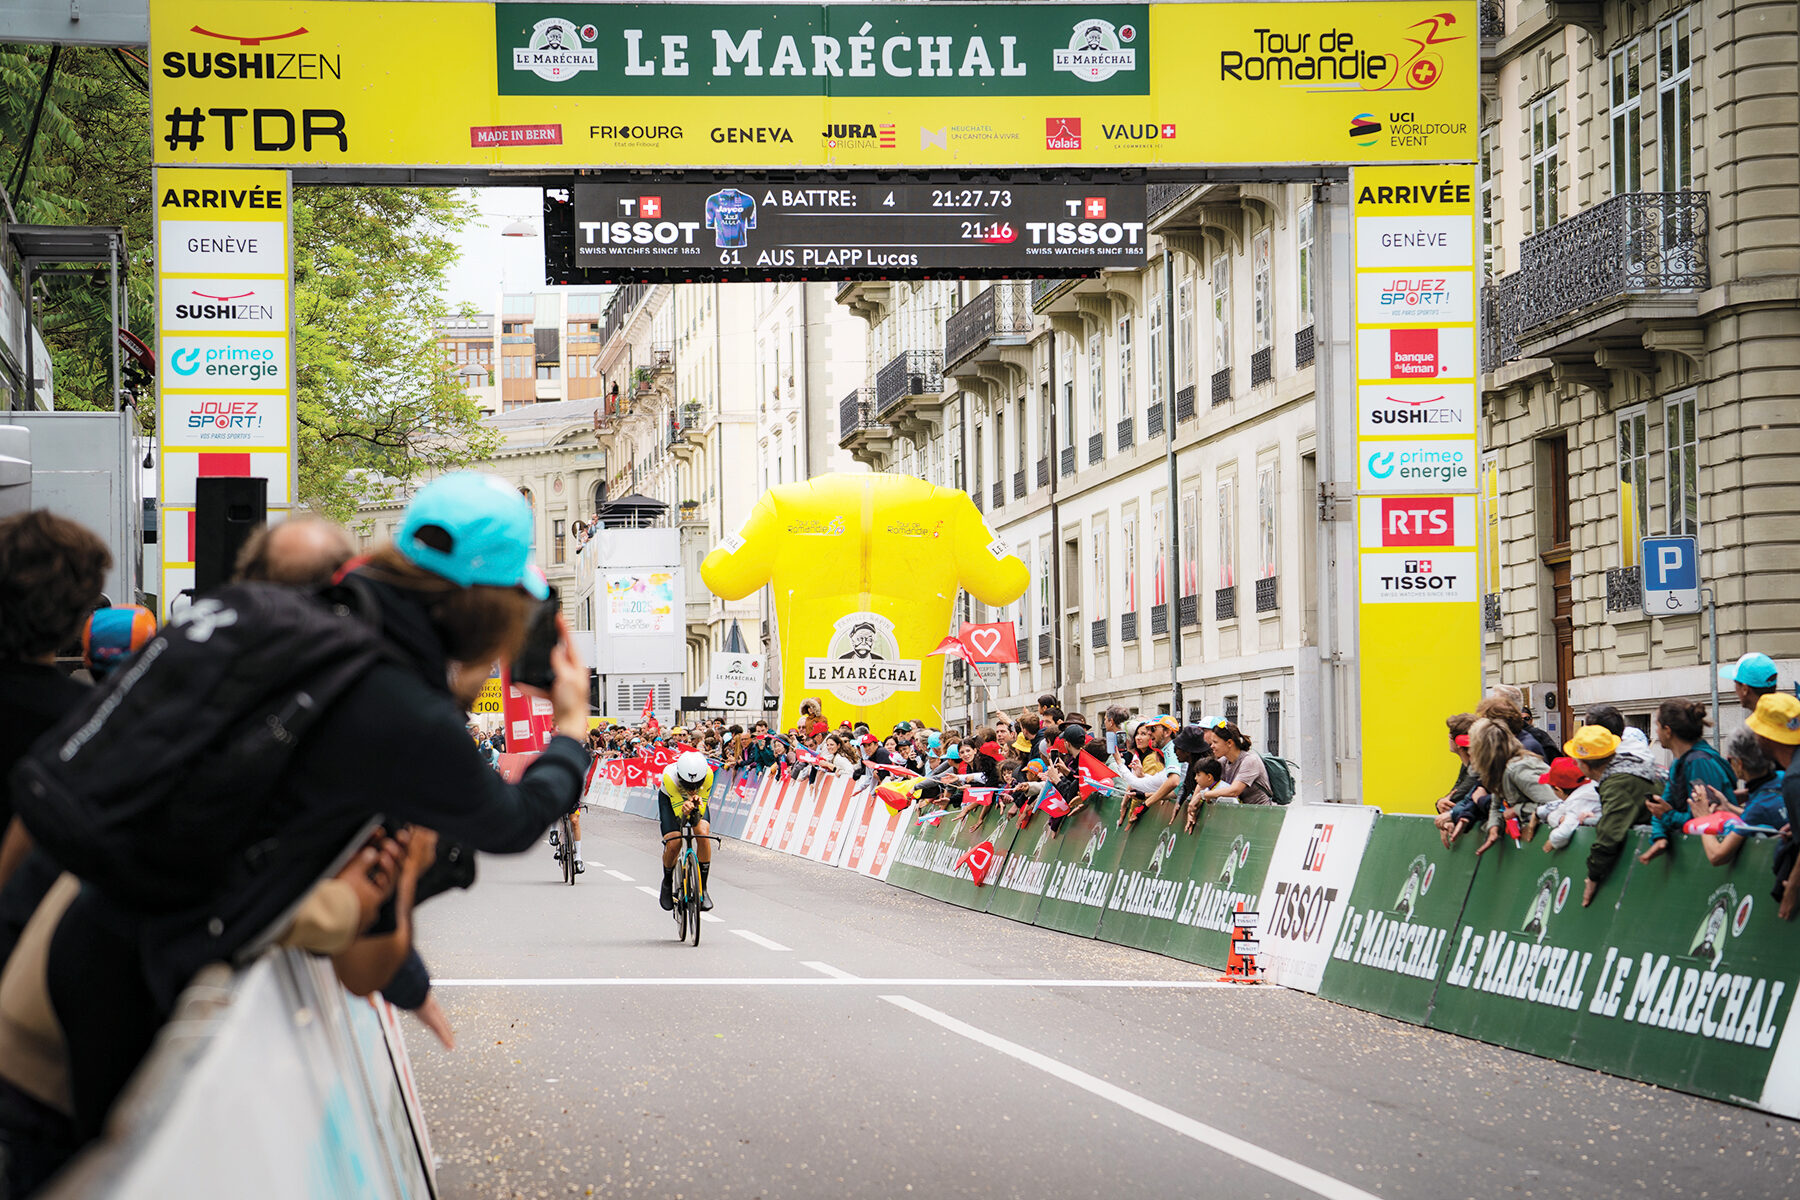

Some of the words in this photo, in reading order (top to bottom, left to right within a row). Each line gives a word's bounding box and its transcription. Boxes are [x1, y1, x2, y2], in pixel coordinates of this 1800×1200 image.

[623, 29, 689, 76] LE
[711, 21, 1027, 78] MARÉCHAL
[1254, 28, 1310, 54] Tour
[1319, 28, 1353, 53] de
[162, 51, 341, 79] SUSHIZEN
[516, 54, 530, 63] LE
[533, 53, 595, 64] MARÉCHAL
[1056, 55, 1069, 64] LE
[1073, 54, 1132, 64] MARÉCHAL
[1221, 50, 1387, 81] Romandie
[1389, 112, 1415, 122] UCI
[164, 106, 348, 152] #TDR
[478, 130, 509, 142] MADE
[511, 130, 525, 141] IN
[526, 129, 555, 140] BERN
[710, 127, 794, 143] GENEVA
[821, 124, 877, 139] JURA
[1101, 124, 1159, 140] VAUD
[1389, 124, 1467, 135] WORLDTOUR
[1047, 137, 1080, 149] Valais
[1391, 136, 1428, 147] EVENT
[161, 184, 282, 209] ARRIVÉE
[762, 190, 778, 207] A
[782, 190, 857, 207] BATTRE:
[882, 190, 896, 207] 4
[931, 190, 1012, 208] 21:27.73
[1357, 179, 1471, 204] ARRIVÉE
[578, 221, 700, 244] TISSOT
[960, 222, 1013, 239] 21:16
[1025, 222, 1144, 245] TISSOT
[1381, 229, 1447, 248] GENÈVE
[187, 235, 258, 253] GENÈVE
[579, 247, 607, 255] SWISS
[1025, 247, 1053, 255] SWISS
[719, 249, 741, 266] 61
[756, 249, 795, 266] AUS
[803, 249, 863, 266] PLAPP
[867, 250, 919, 266] Lucas
[1382, 279, 1447, 292] JOUEZ
[175, 304, 273, 320] SUSHIZEN
[206, 345, 274, 363] primeo
[1394, 352, 1434, 364] banque
[205, 361, 278, 381] energie
[1401, 363, 1434, 374] léman
[190, 402, 259, 414] JOUEZ
[1371, 409, 1462, 424] SUSHIZEN
[1400, 448, 1464, 466] primeo
[1400, 463, 1468, 482] energie
[1388, 509, 1448, 535] RTS
[1657, 546, 1683, 584] P
[1381, 576, 1457, 590] TISSOT
[808, 666, 827, 680] LE
[831, 664, 917, 682] MARÉCHAL
[478, 701, 499, 712] 100
[724, 690, 747, 707] 50
[764, 700, 777, 708] VIP
[1045, 860, 1067, 899] LE
[1108, 868, 1130, 911] LE
[1176, 879, 1201, 925] LE
[1267, 881, 1339, 944] TISSOT
[1332, 905, 1363, 961] LE
[1446, 925, 1485, 988] LE
[1588, 946, 1633, 1018] LE
